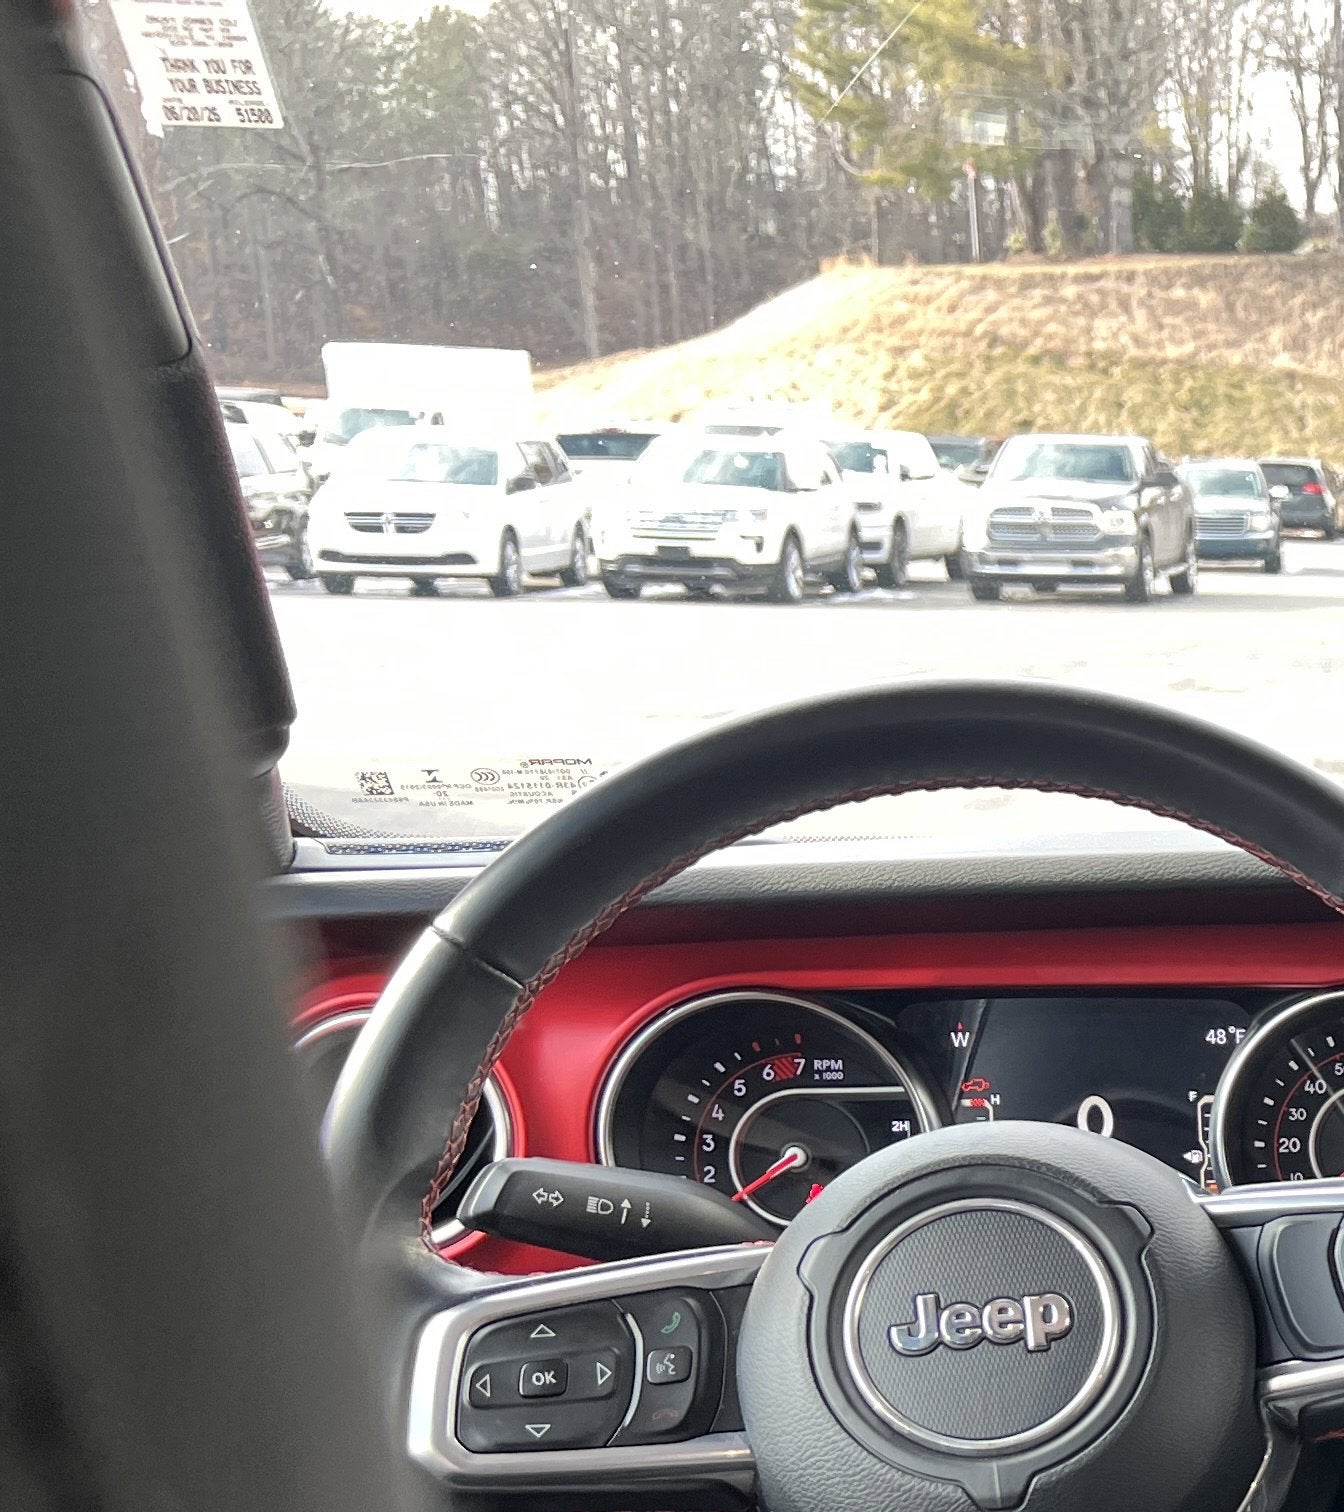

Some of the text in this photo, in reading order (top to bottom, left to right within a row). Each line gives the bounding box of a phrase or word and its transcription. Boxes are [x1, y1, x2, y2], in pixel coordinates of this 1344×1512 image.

[204, 59, 227, 74] YOU
[230, 59, 256, 75] FOR
[167, 78, 262, 95] YOUR BUSINESS
[951, 1032, 970, 1048] W
[1205, 1026, 1246, 1045] 48°F
[762, 1064, 775, 1082] 6
[794, 1058, 806, 1076] 7
[814, 1060, 843, 1072] RPM
[734, 1080, 746, 1096] 5
[1304, 1080, 1327, 1095] 40
[991, 1094, 1000, 1105] H
[711, 1104, 724, 1121] 4
[1288, 1108, 1306, 1121] 30
[702, 1134, 715, 1152] 3
[1278, 1138, 1300, 1153] 20
[702, 1166, 717, 1183] 2
[888, 1291, 1074, 1355] Jeep
[532, 1370, 556, 1386] OK
